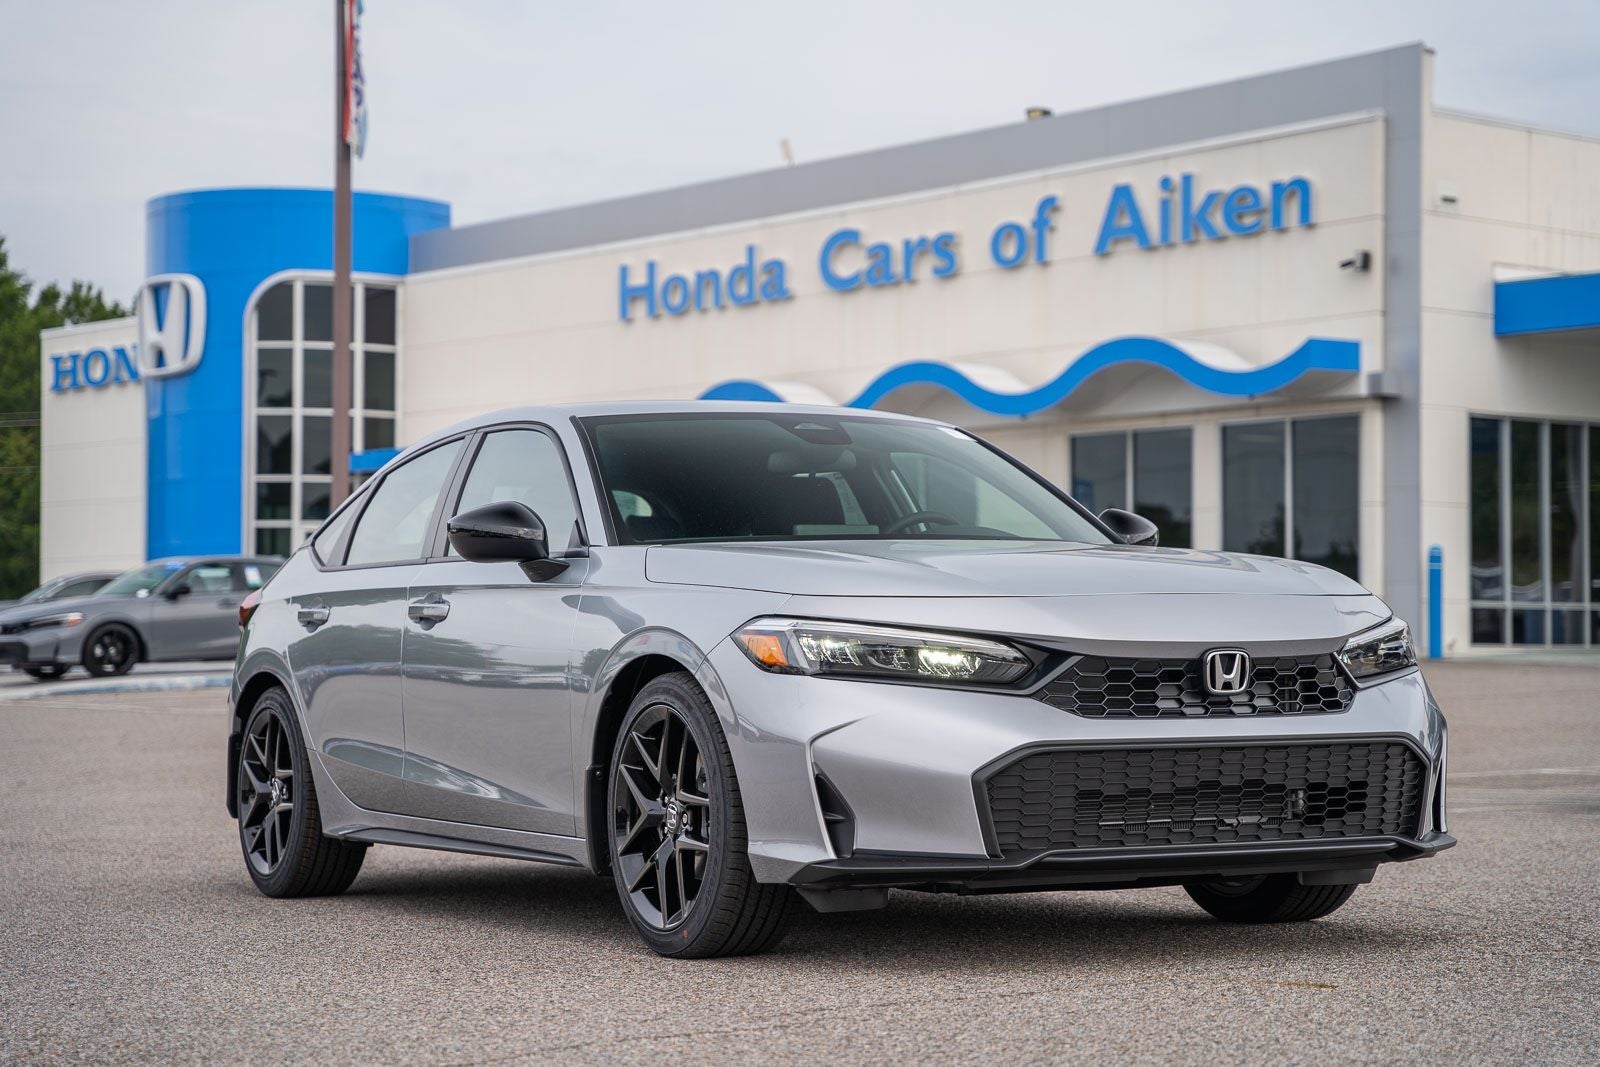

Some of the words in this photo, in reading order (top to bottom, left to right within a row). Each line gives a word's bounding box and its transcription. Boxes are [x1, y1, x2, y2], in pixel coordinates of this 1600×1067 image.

[619, 246, 790, 321] Honda
[819, 229, 959, 292] Cars
[990, 196, 1061, 269] of
[1095, 174, 1313, 256] Aiken
